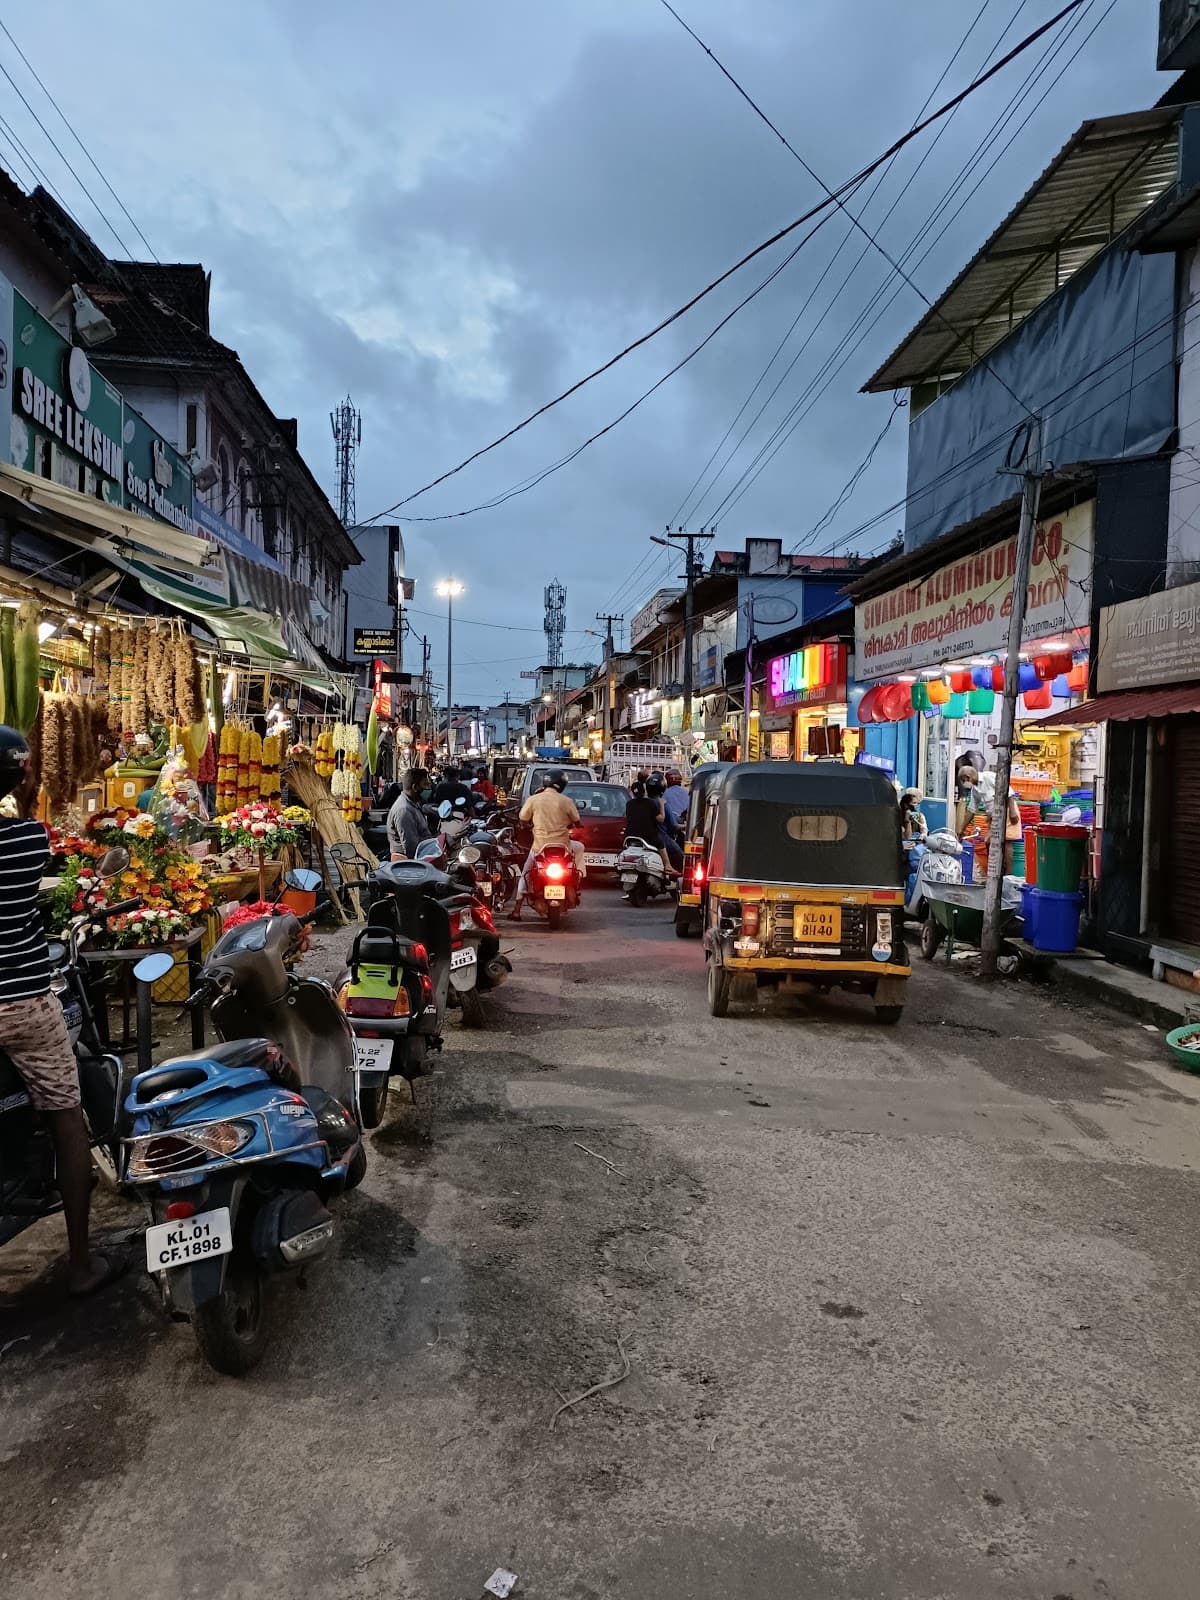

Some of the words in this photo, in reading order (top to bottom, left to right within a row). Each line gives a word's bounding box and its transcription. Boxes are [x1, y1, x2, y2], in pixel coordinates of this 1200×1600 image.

[20, 366, 63, 439] SREE
[127, 461, 148, 504] Sree
[863, 588, 922, 630] SIVAKAMI
[367, 1048, 381, 1056] 22
[159, 1236, 222, 1265] CF.1898
[167, 1223, 211, 1247] KL.01
